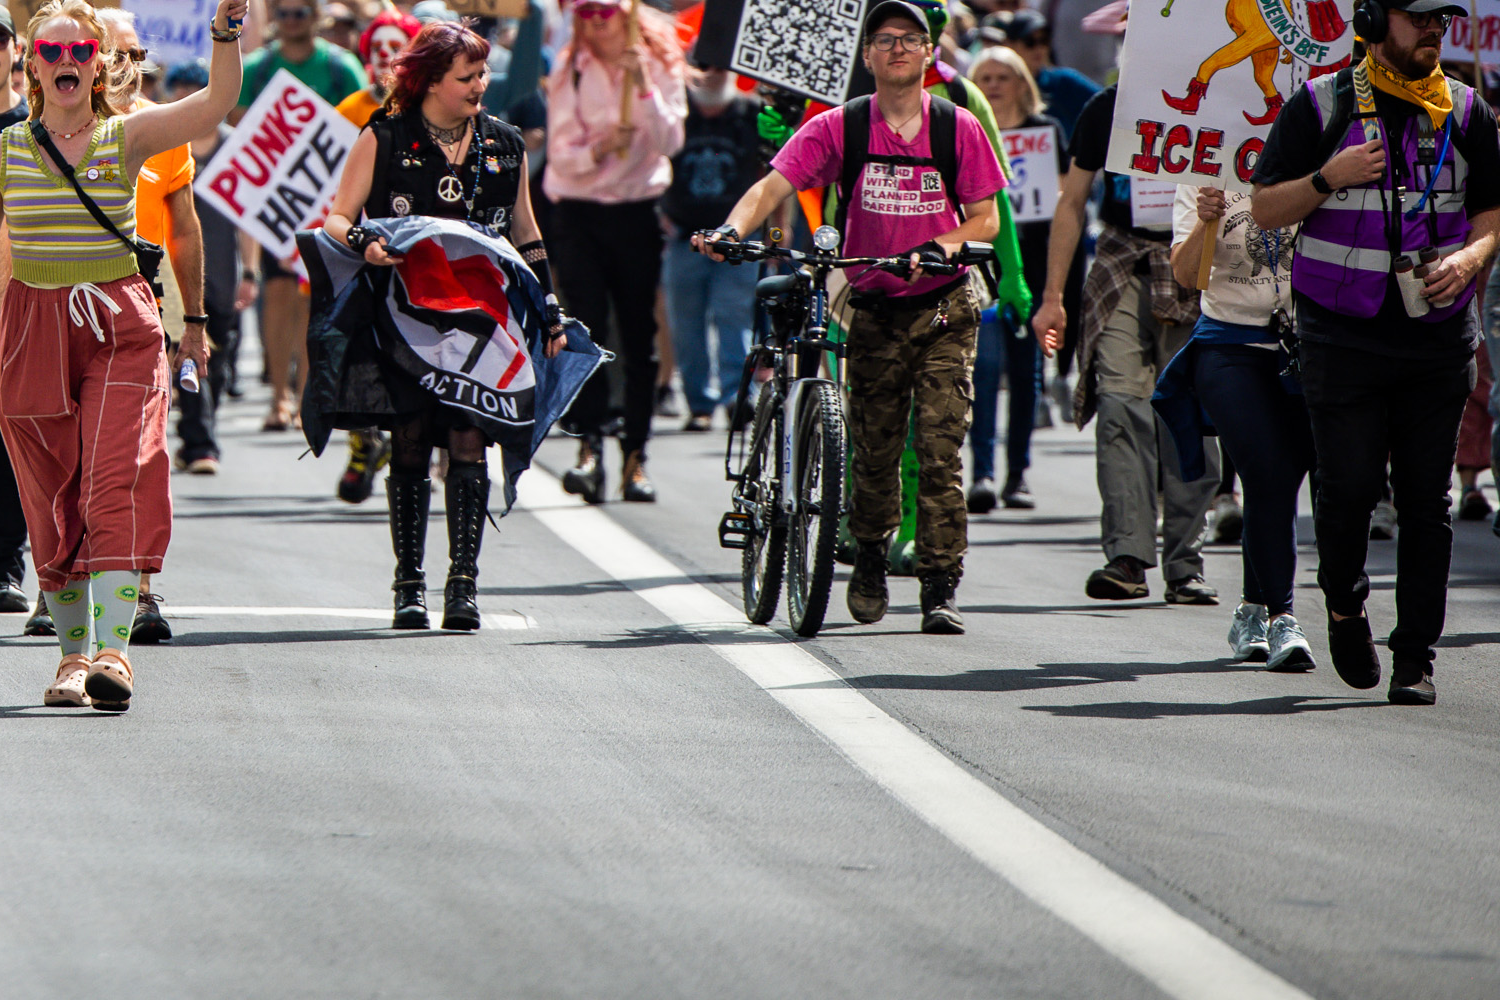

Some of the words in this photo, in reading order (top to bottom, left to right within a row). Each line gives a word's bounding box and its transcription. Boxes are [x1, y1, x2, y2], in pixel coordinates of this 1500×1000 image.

[1294, 37, 1330, 63] BFF
[208, 85, 317, 218] PUNKS
[1130, 118, 1226, 178] ICE
[255, 119, 347, 245] HATE
[862, 189, 919, 201] PLANNED
[865, 176, 898, 188] WITH
[862, 200, 944, 214] PARENTHOOD
[419, 370, 520, 420] ACTION
